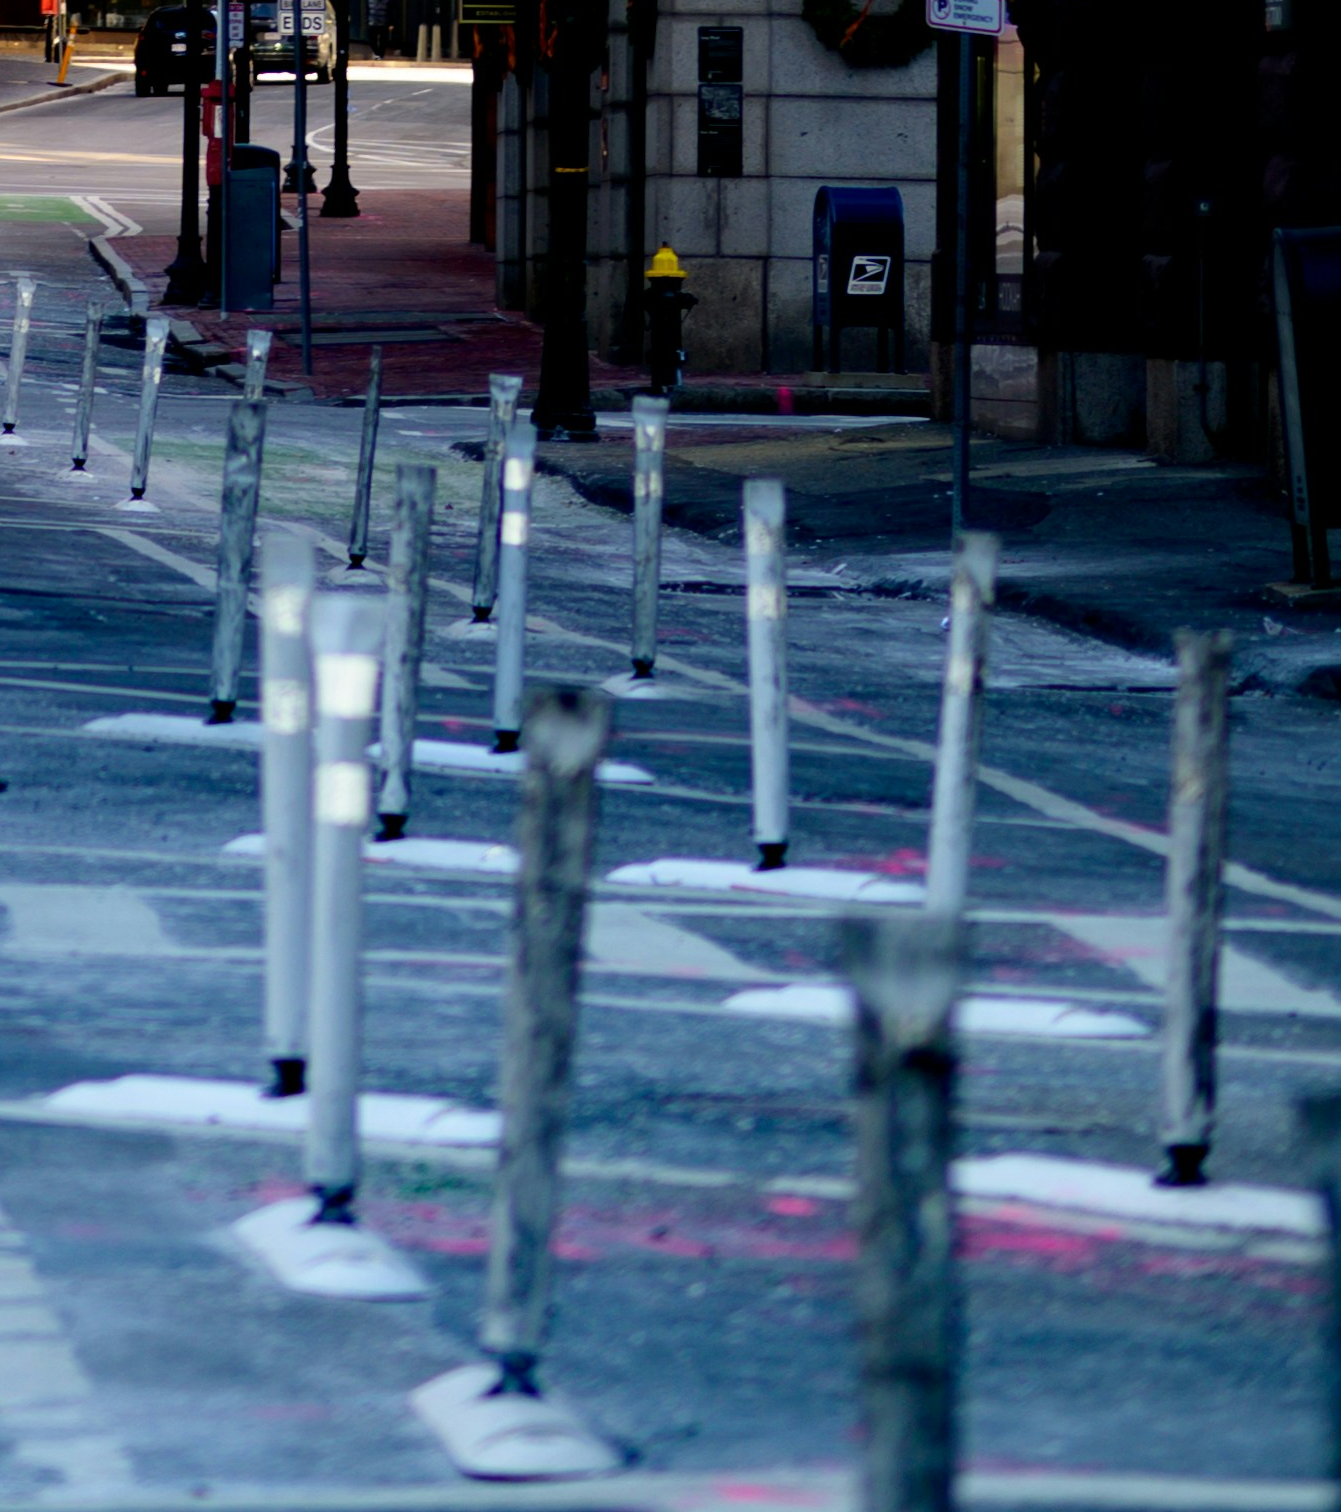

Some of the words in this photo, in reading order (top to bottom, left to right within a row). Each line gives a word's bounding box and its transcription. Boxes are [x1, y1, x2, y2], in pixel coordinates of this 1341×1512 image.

[302, 0, 322, 8] LANE
[954, 4, 973, 12] SNOW
[953, 12, 994, 23] EMERGENCY
[283, 16, 323, 30] EDS
